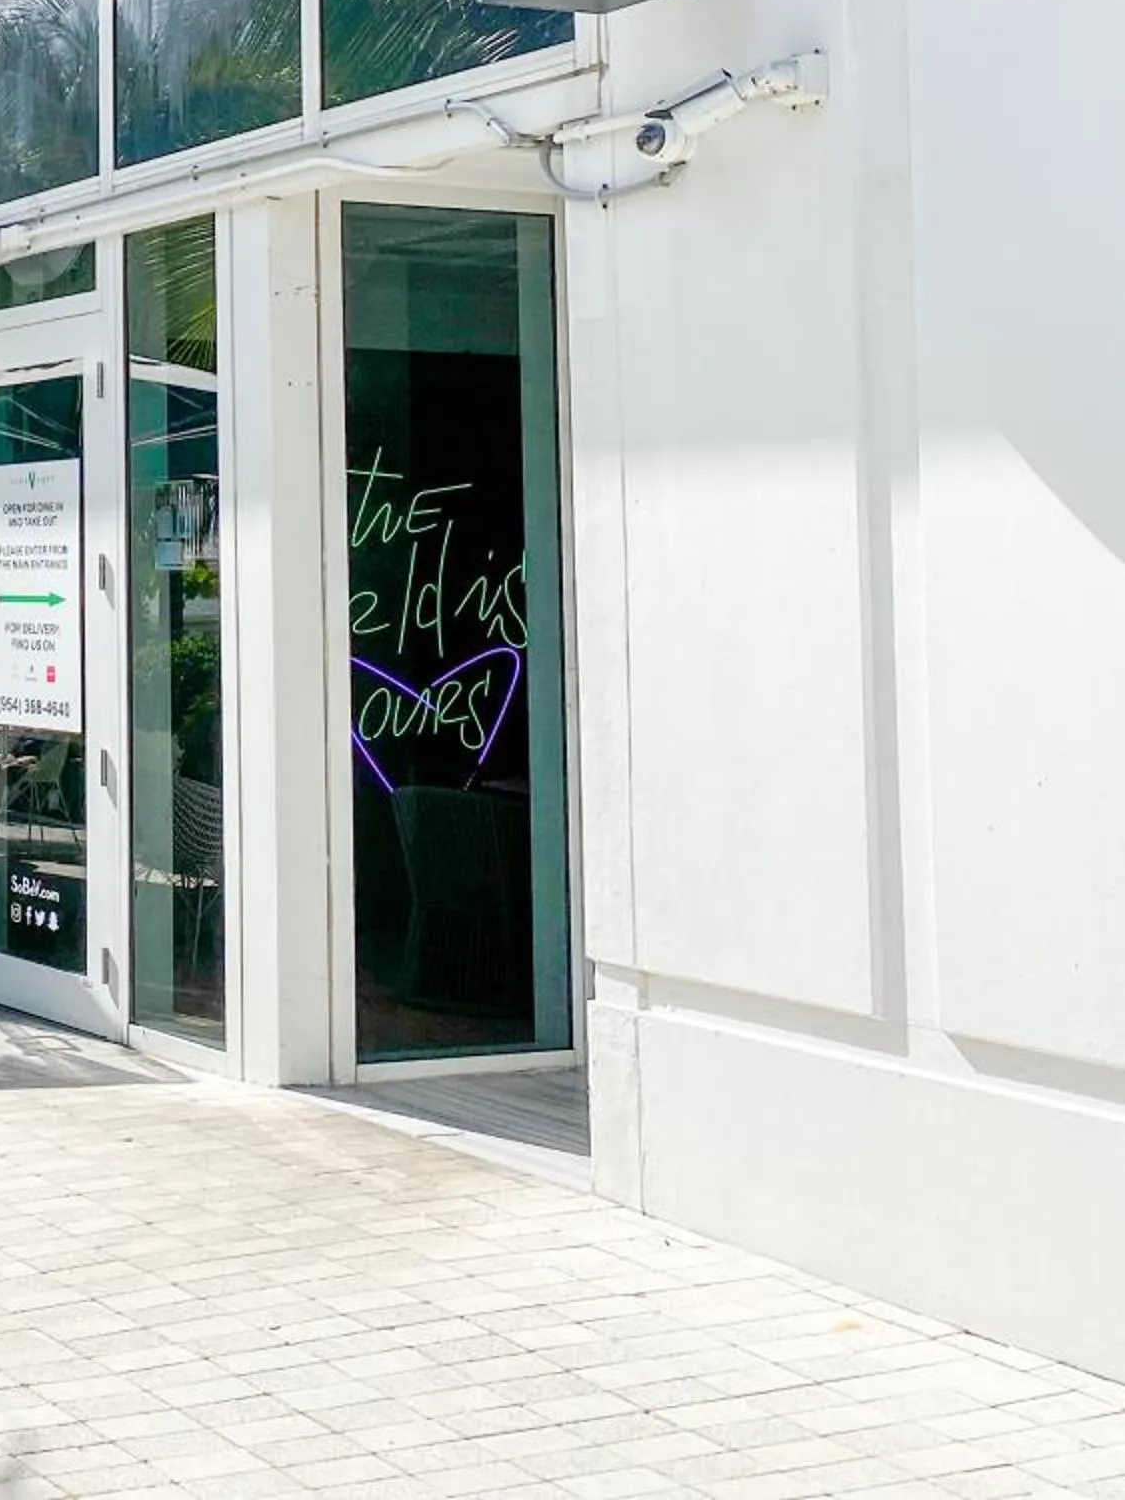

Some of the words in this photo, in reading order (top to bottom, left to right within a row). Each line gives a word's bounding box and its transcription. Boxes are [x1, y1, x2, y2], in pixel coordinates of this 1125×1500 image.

[2, 503, 21, 514] OPEN
[24, 516, 41, 526] TAKE
[42, 515, 58, 526] OUT
[24, 545, 47, 556] ENTER
[4, 622, 21, 633] FOR
[22, 623, 60, 635] DELIVERY
[30, 639, 41, 651] US
